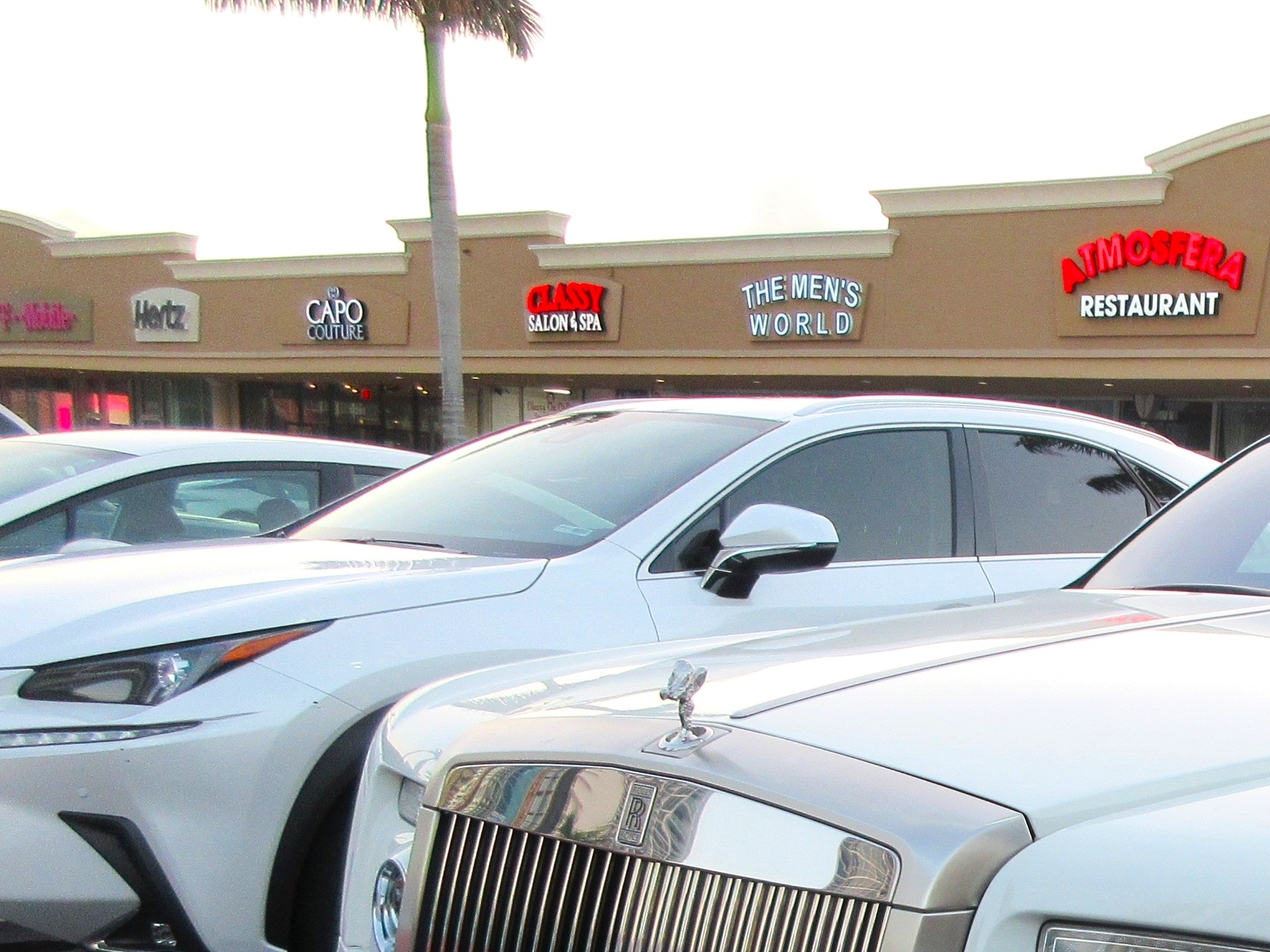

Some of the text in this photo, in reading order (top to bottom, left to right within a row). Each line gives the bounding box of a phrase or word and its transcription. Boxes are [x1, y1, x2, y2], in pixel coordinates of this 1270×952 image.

[1061, 230, 1247, 294] ATMOSFERA
[526, 282, 605, 315] CLASSY
[741, 273, 863, 309] THE MEN'S
[1080, 291, 1220, 318] RESTAURANT
[135, 300, 187, 330] Hertz
[306, 299, 364, 325] CAPO
[528, 310, 603, 333] SALON & SPA
[749, 311, 853, 337] WORLD
[307, 324, 365, 340] COUTURE
